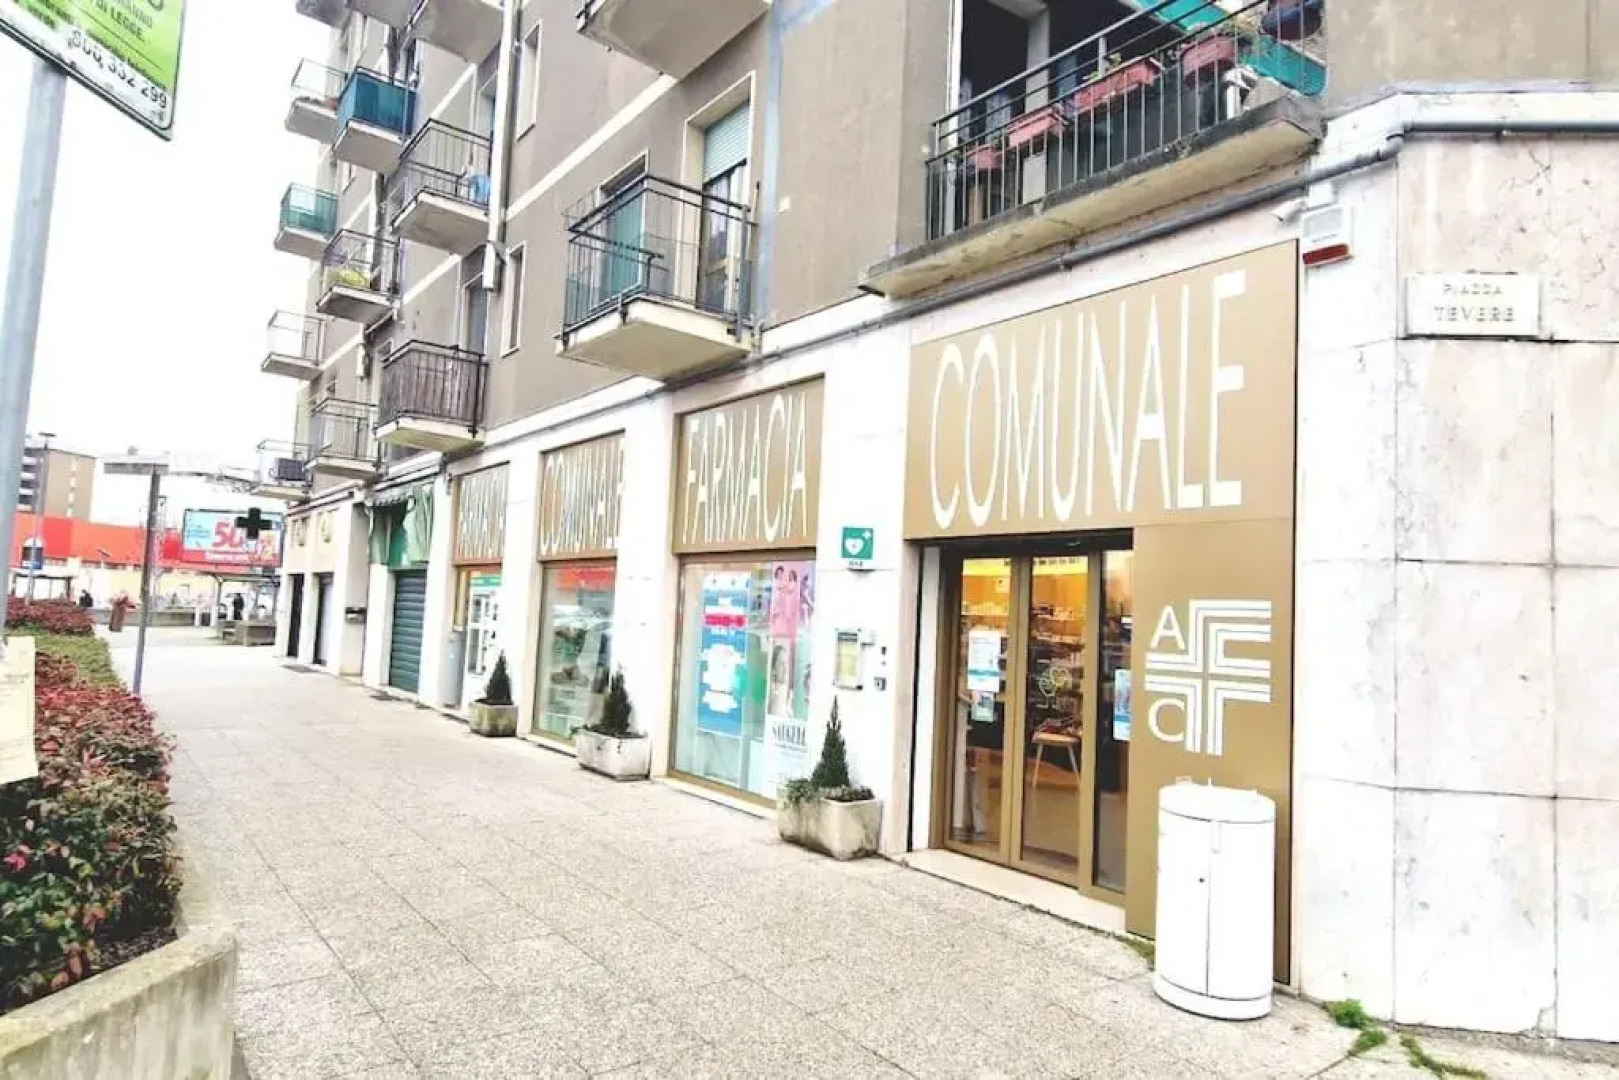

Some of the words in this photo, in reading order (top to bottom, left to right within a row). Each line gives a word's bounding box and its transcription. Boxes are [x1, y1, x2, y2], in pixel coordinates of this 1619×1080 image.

[1433, 306, 1514, 322] TEVERE
[1442, 282, 1503, 295] PIAZZA
[930, 270, 1246, 530] COMUNALE
[682, 391, 808, 545] FARMACIA
